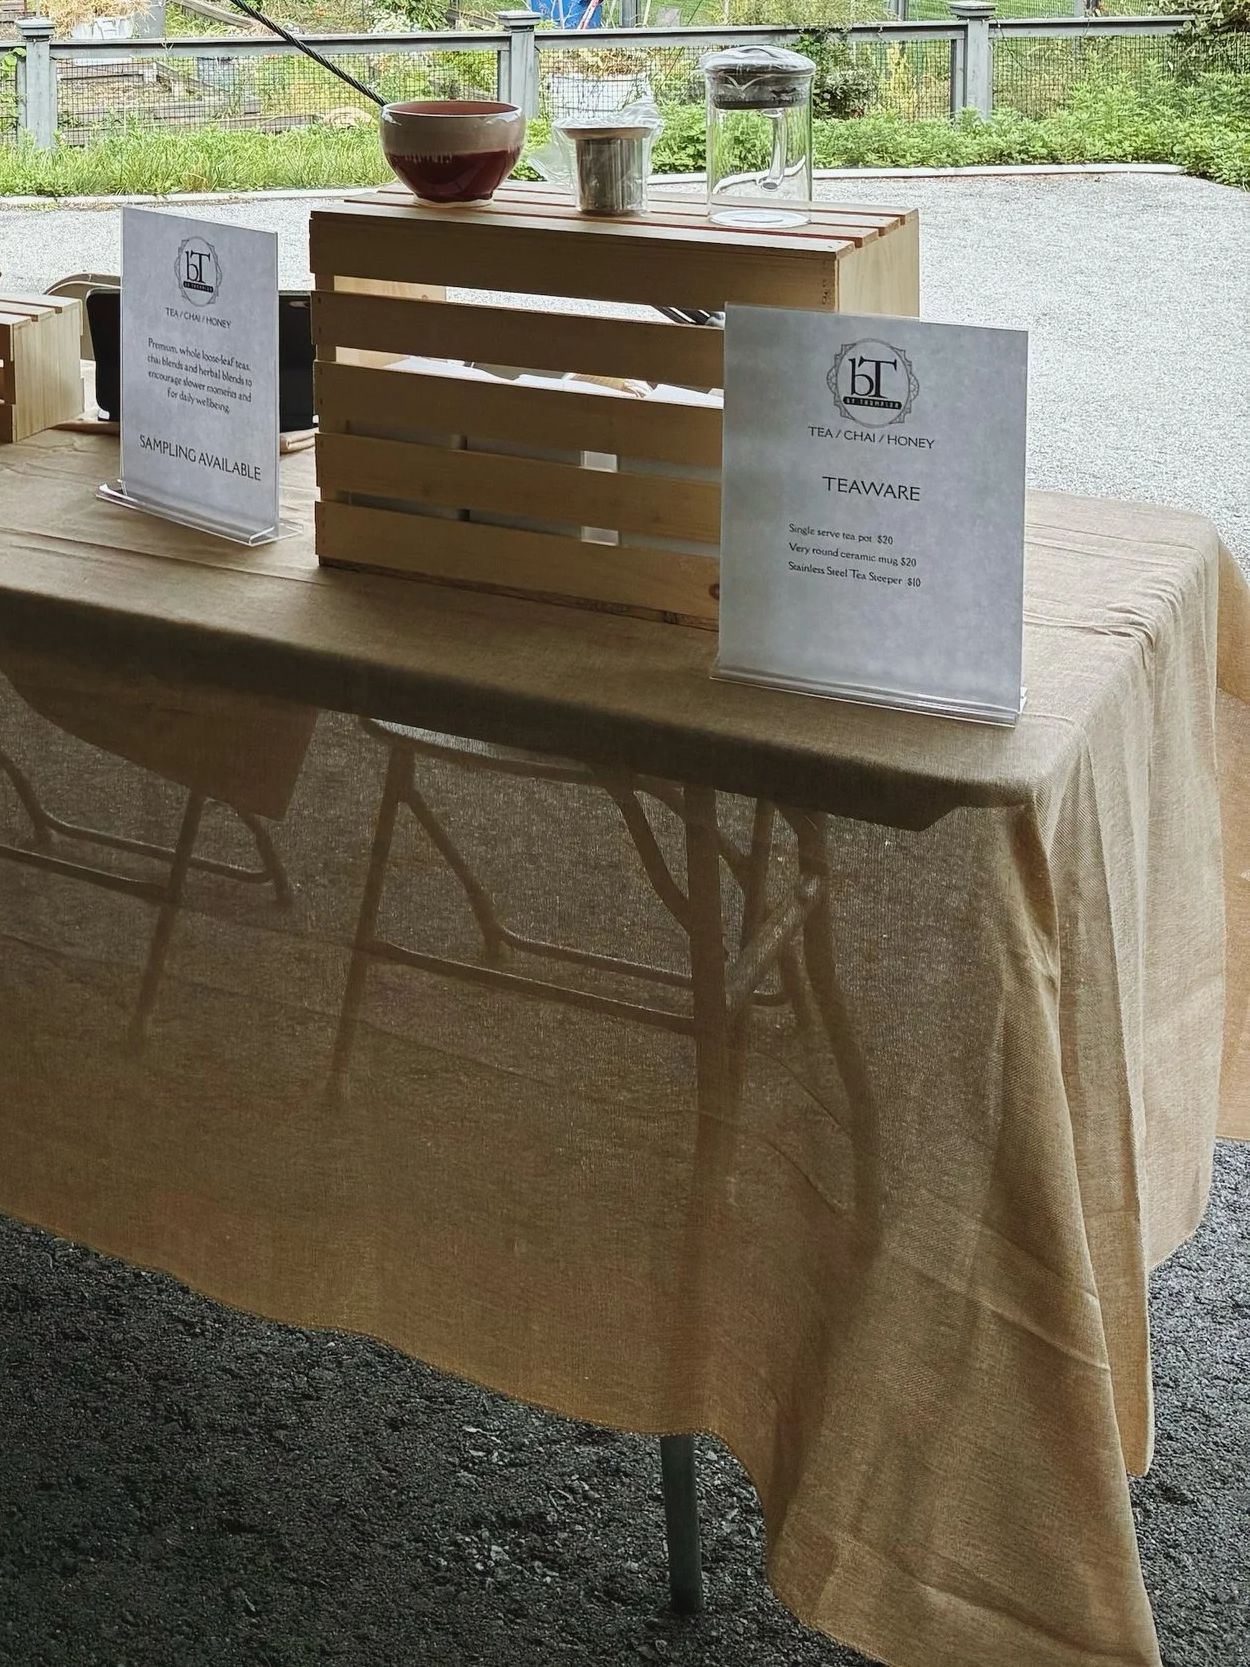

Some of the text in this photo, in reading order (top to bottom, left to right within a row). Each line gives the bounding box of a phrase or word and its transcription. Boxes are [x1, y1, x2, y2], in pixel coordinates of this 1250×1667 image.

[165, 307, 179, 318] TEA
[183, 311, 201, 323] CHAI
[206, 317, 232, 329] HONEY
[179, 346, 201, 359] whole
[147, 354, 253, 387] chai blends and herbal blends to
[148, 370, 252, 403] encourage slower moments and
[179, 391, 195, 405] daily
[808, 425, 833, 439] TEA
[843, 430, 876, 443] CHAI
[887, 435, 935, 449] HONEY
[139, 434, 262, 481] SAMPLING AVAILABLE
[822, 476, 921, 502] TEAWARE
[788, 523, 894, 545] Single serve tea pot $20
[788, 542, 917, 568] Very round ceramic mug $20
[788, 561, 921, 588] Stainless Steel Tea Steeper $10
